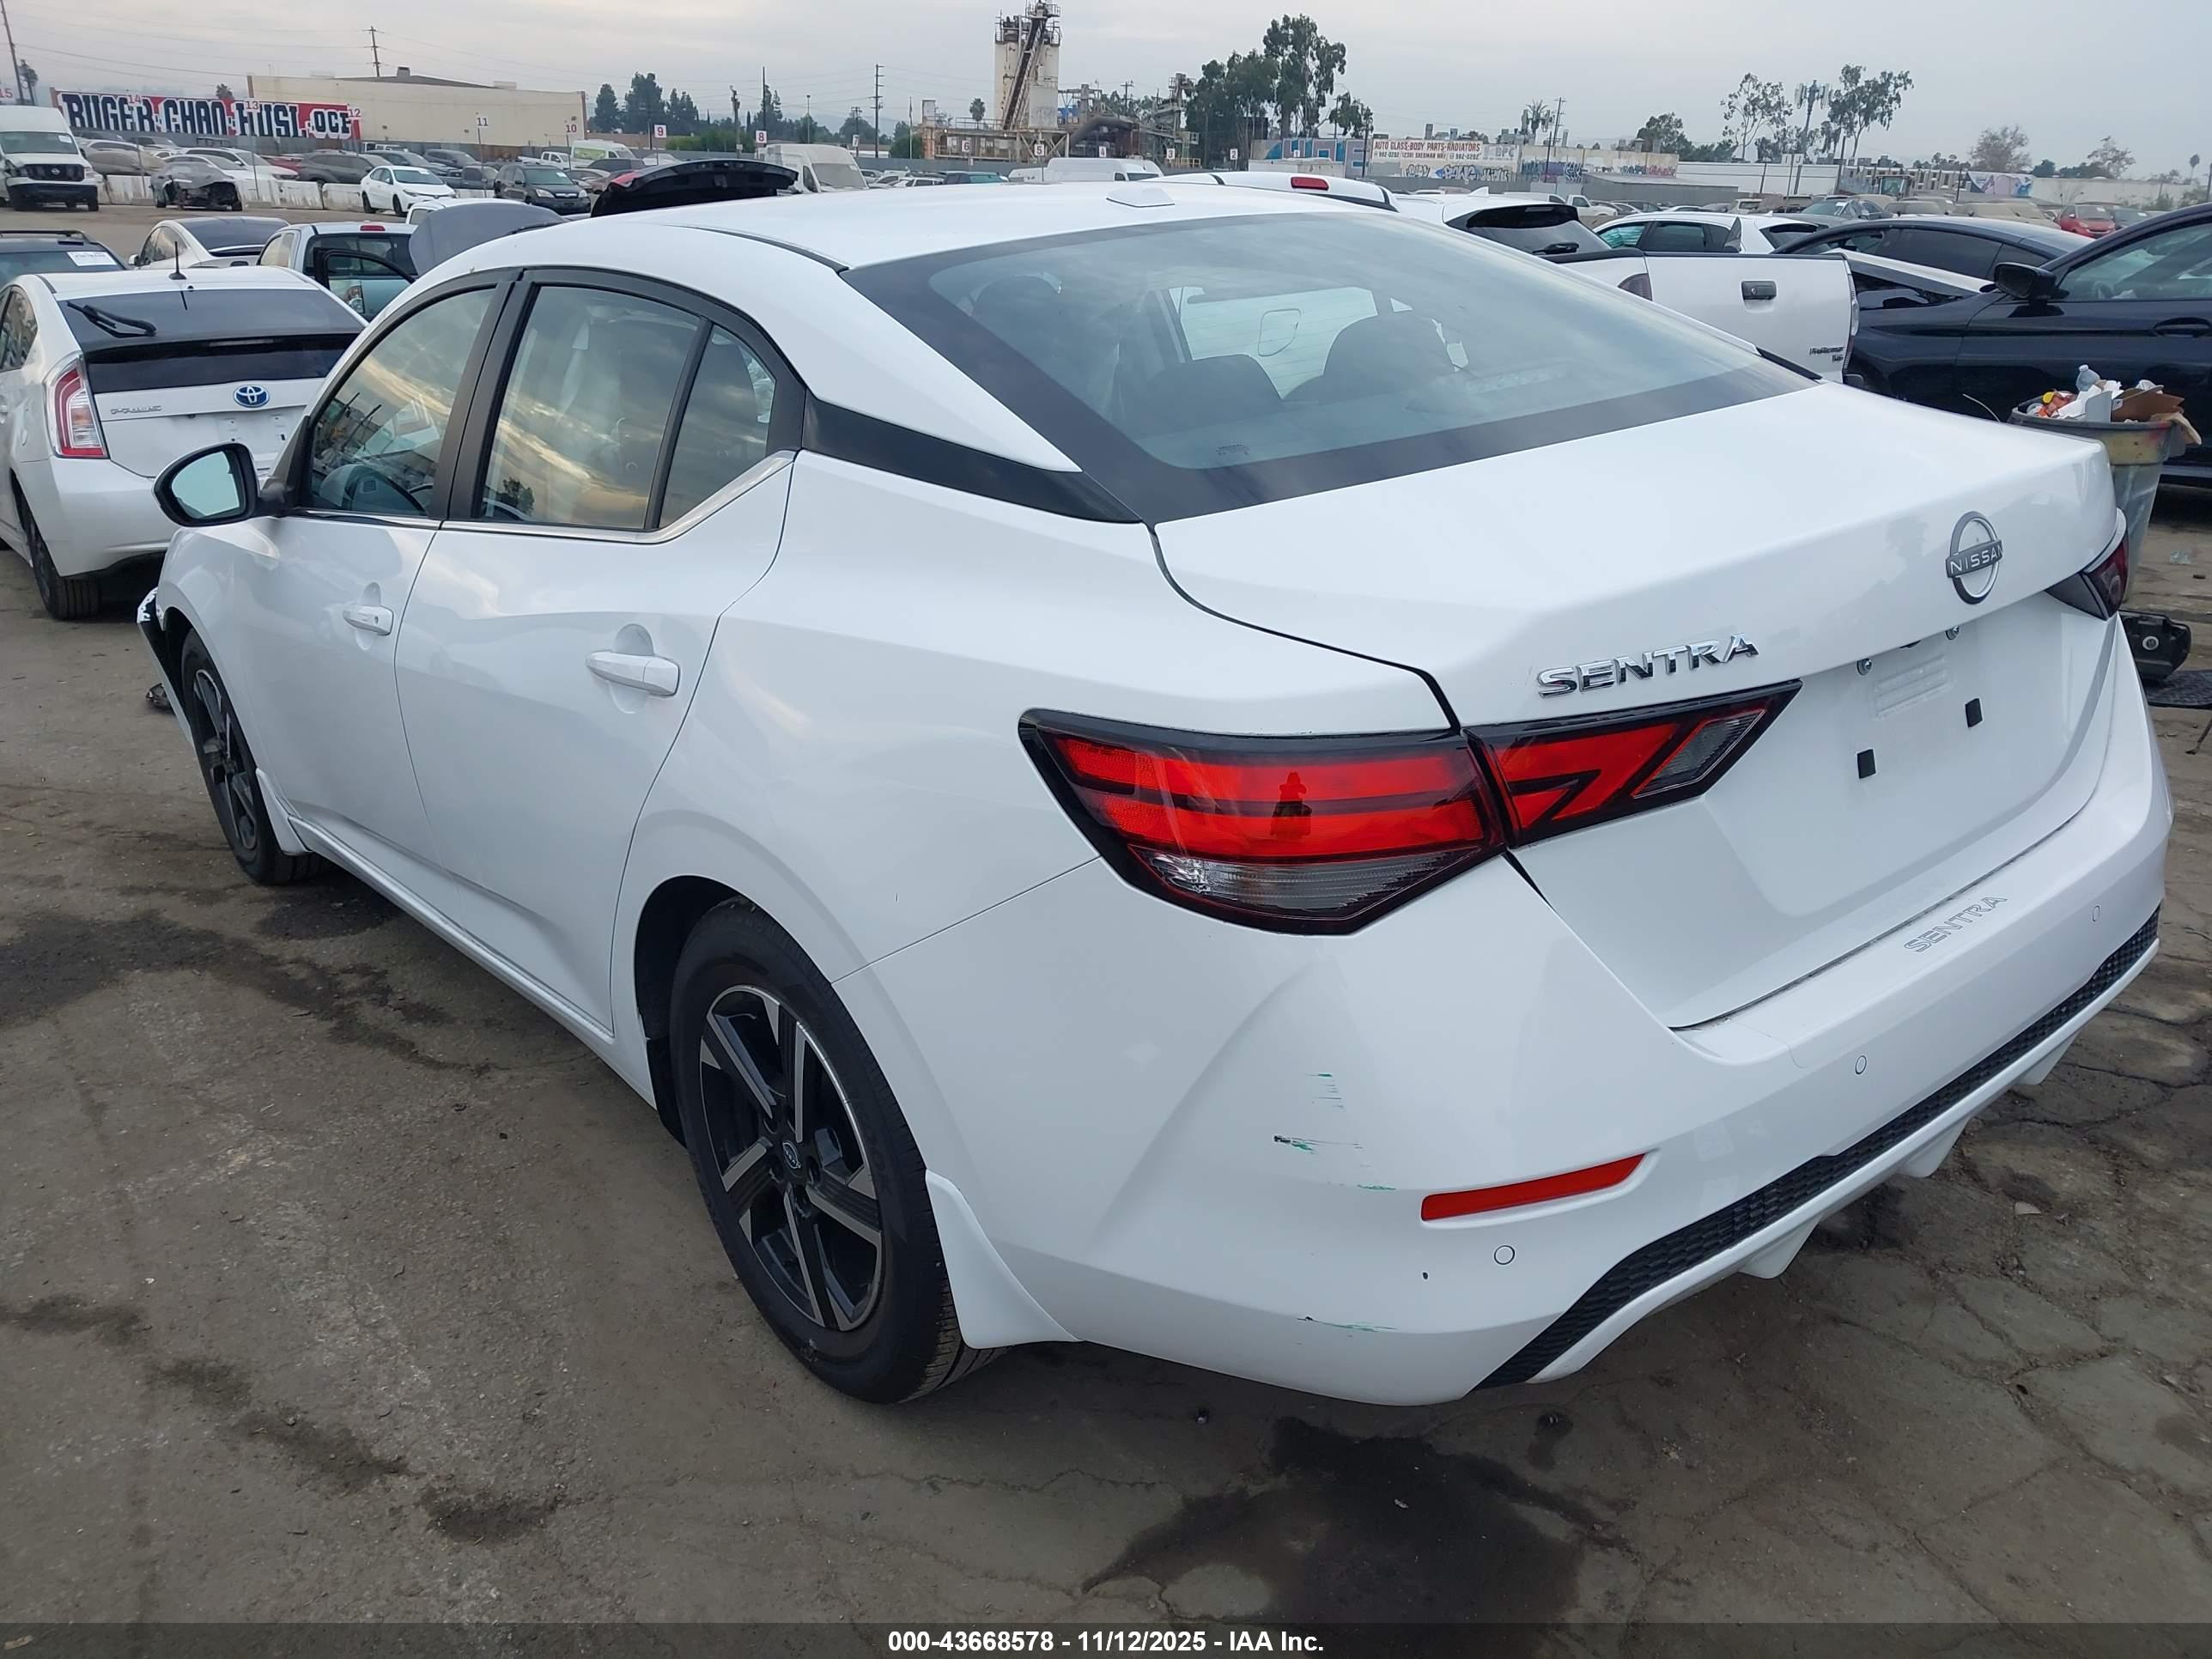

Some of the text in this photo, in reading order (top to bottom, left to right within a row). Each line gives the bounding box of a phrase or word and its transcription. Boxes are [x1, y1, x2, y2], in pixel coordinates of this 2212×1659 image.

[130, 94, 141, 104] 14
[246, 101, 258, 110] 13
[477, 118, 489, 126] 11
[566, 124, 577, 133] 10
[1374, 141, 1389, 150] AUTO
[1950, 544, 2002, 574] NISSAN
[1537, 633, 1759, 698] SENTRA
[1904, 896, 2008, 952] SENTRA
